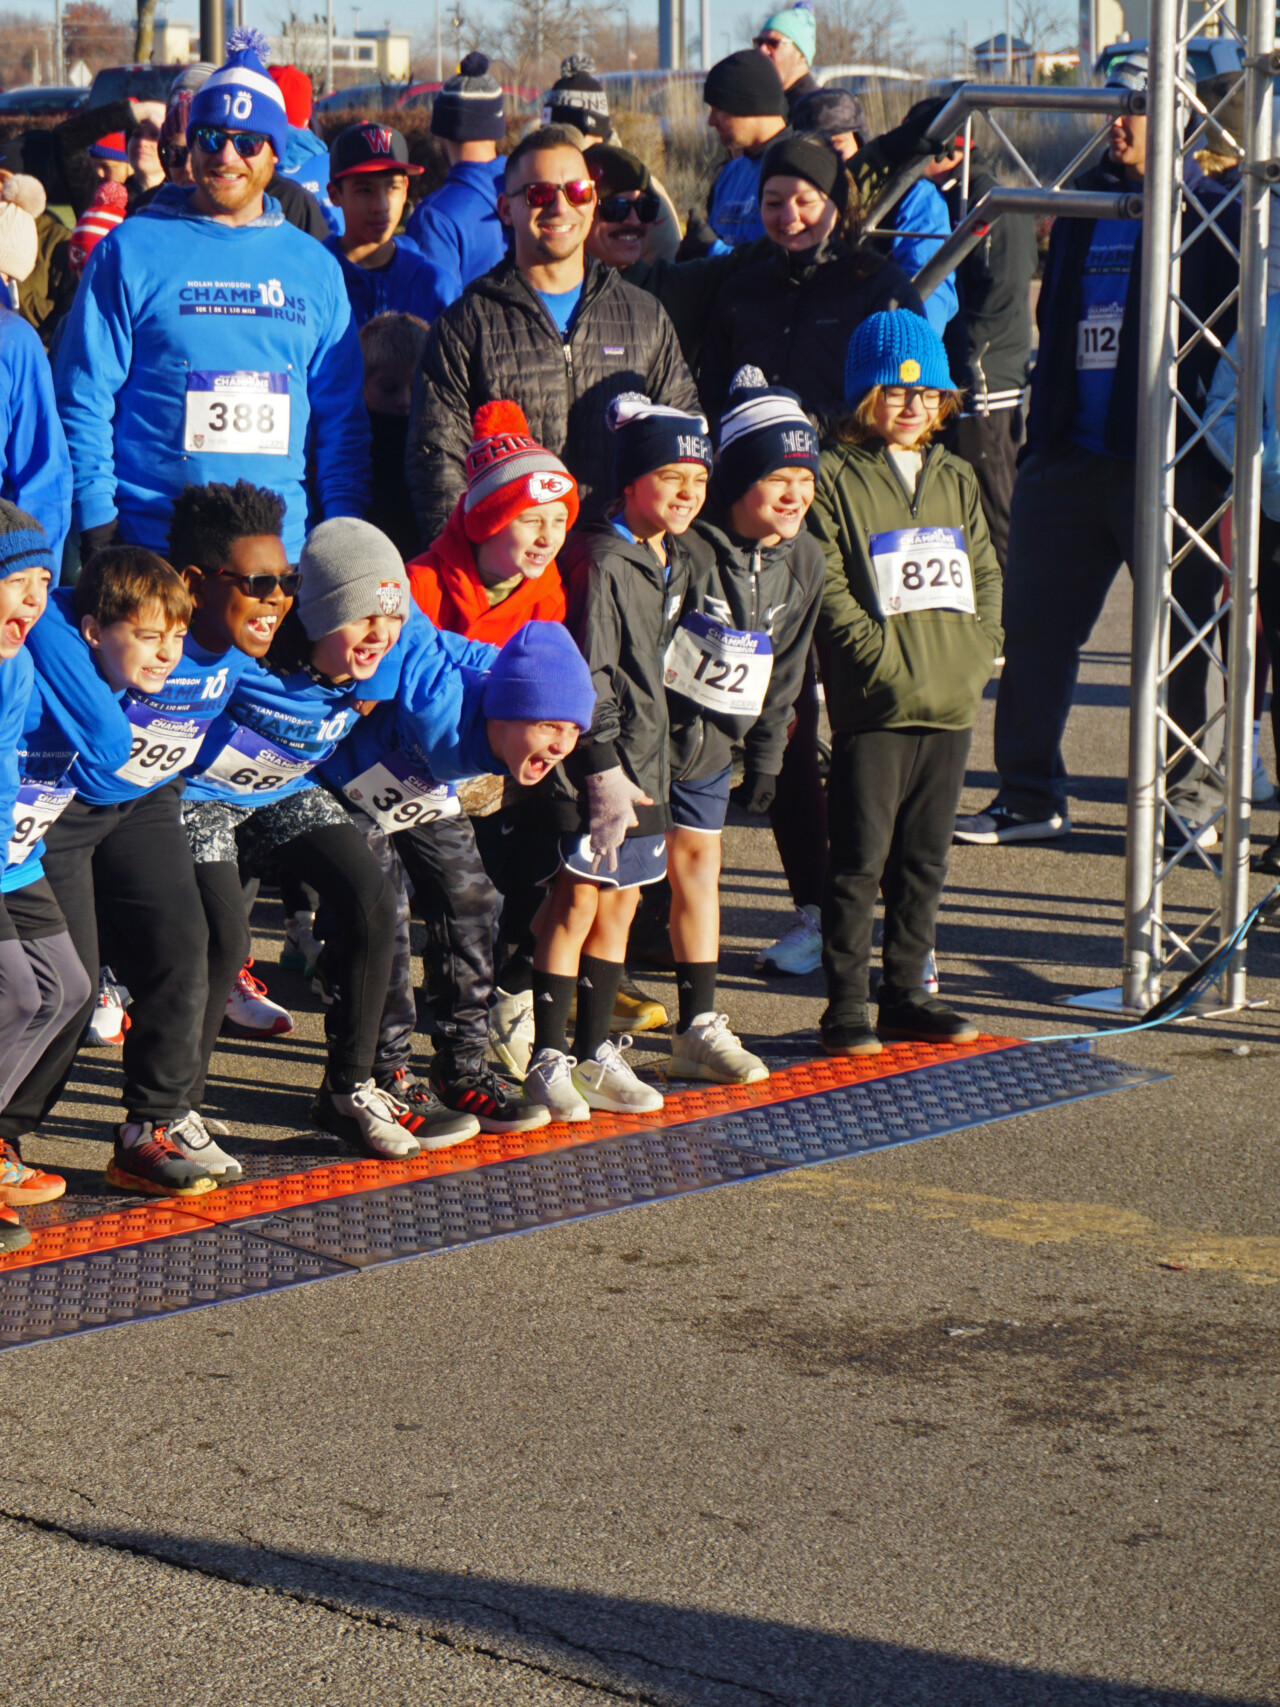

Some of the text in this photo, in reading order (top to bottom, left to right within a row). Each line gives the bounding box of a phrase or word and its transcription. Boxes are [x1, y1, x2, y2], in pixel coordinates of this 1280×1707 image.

[224, 92, 252, 120] 10
[361, 128, 392, 154] W
[215, 281, 251, 289] DAVIDSON
[273, 311, 306, 326] RUN
[209, 402, 274, 433] 388
[902, 558, 963, 590] 826
[694, 649, 749, 693] 122
[274, 711, 313, 725] DAVIDSON
[289, 741, 305, 749] MILE
[373, 787, 443, 826] 390
